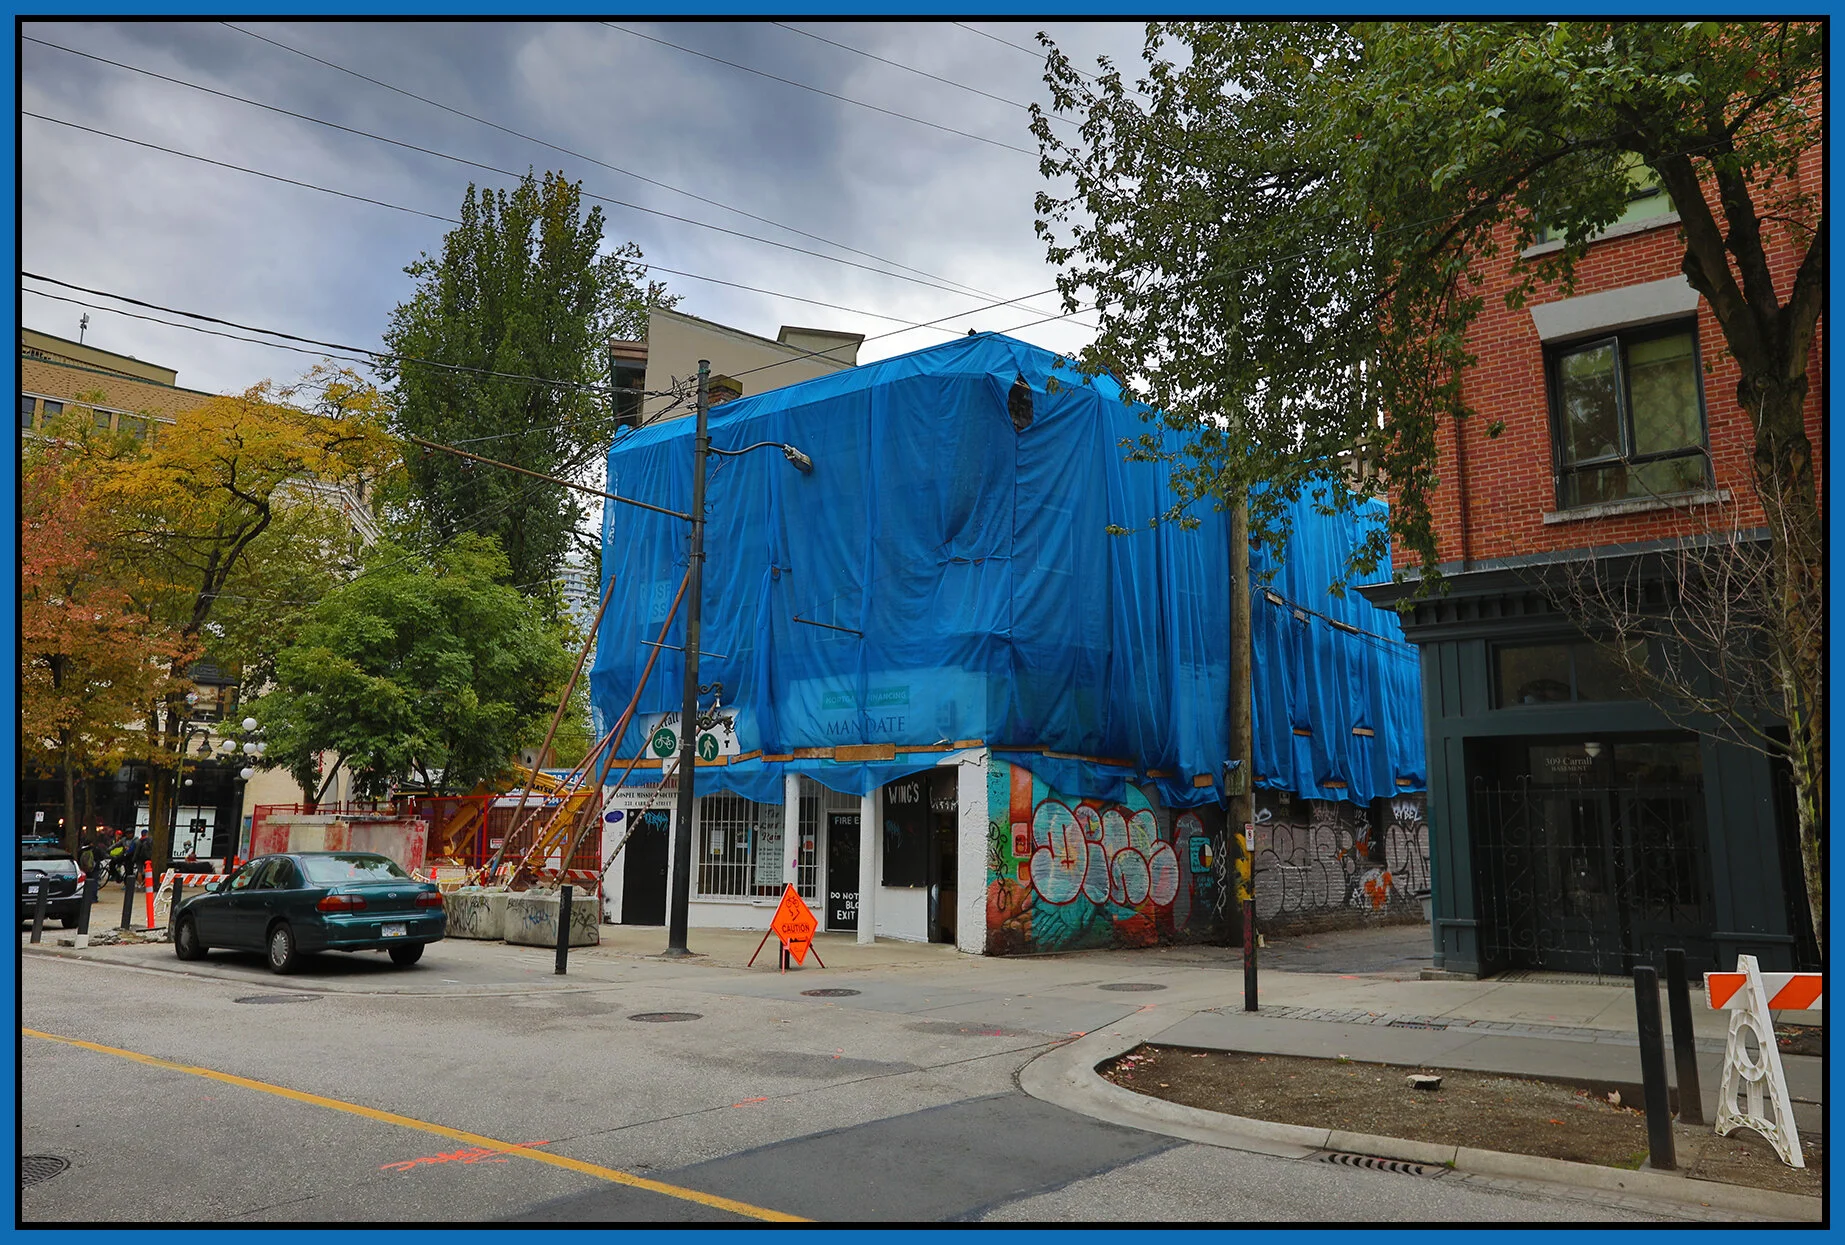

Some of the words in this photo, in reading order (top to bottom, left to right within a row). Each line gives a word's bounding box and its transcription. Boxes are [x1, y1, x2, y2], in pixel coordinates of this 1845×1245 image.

[826, 715, 905, 736] MANDATE
[1545, 757, 1561, 767] 309
[1562, 756, 1592, 766] Carrall
[834, 816, 852, 825] FIRE
[830, 891, 841, 899] DO
[842, 892, 859, 900] NOT
[836, 909, 856, 921] EXIT
[781, 924, 810, 934] CAUTION
